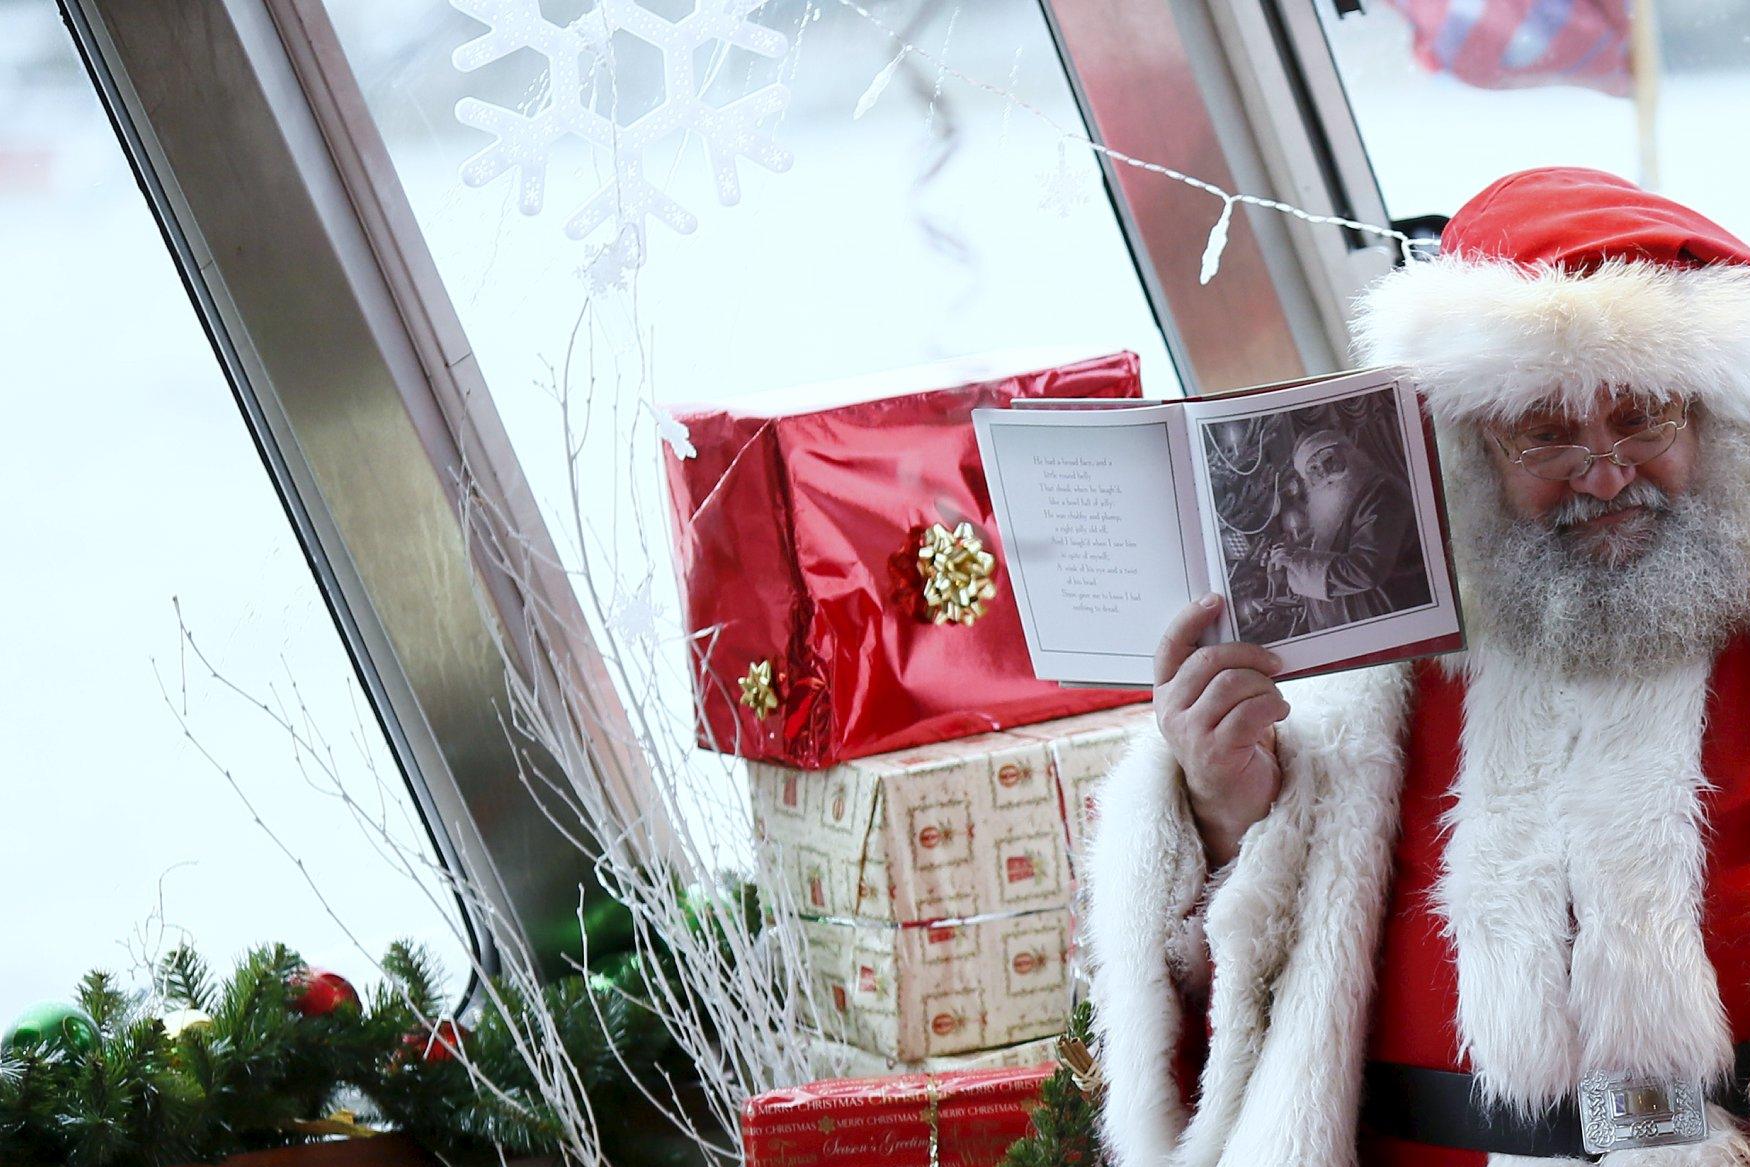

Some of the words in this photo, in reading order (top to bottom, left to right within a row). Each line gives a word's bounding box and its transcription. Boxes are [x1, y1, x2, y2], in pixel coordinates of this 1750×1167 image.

[797, 1097, 865, 1112] CHRISTMAS
[765, 1122, 818, 1135] CHRISTMAS
[836, 1115, 865, 1128] MERRY
[866, 1111, 919, 1124] CHRISTMAS
[939, 1108, 966, 1119] MERRY
[967, 1103, 1020, 1117] CHRISTMAS
[822, 1136, 876, 1157] Season's
